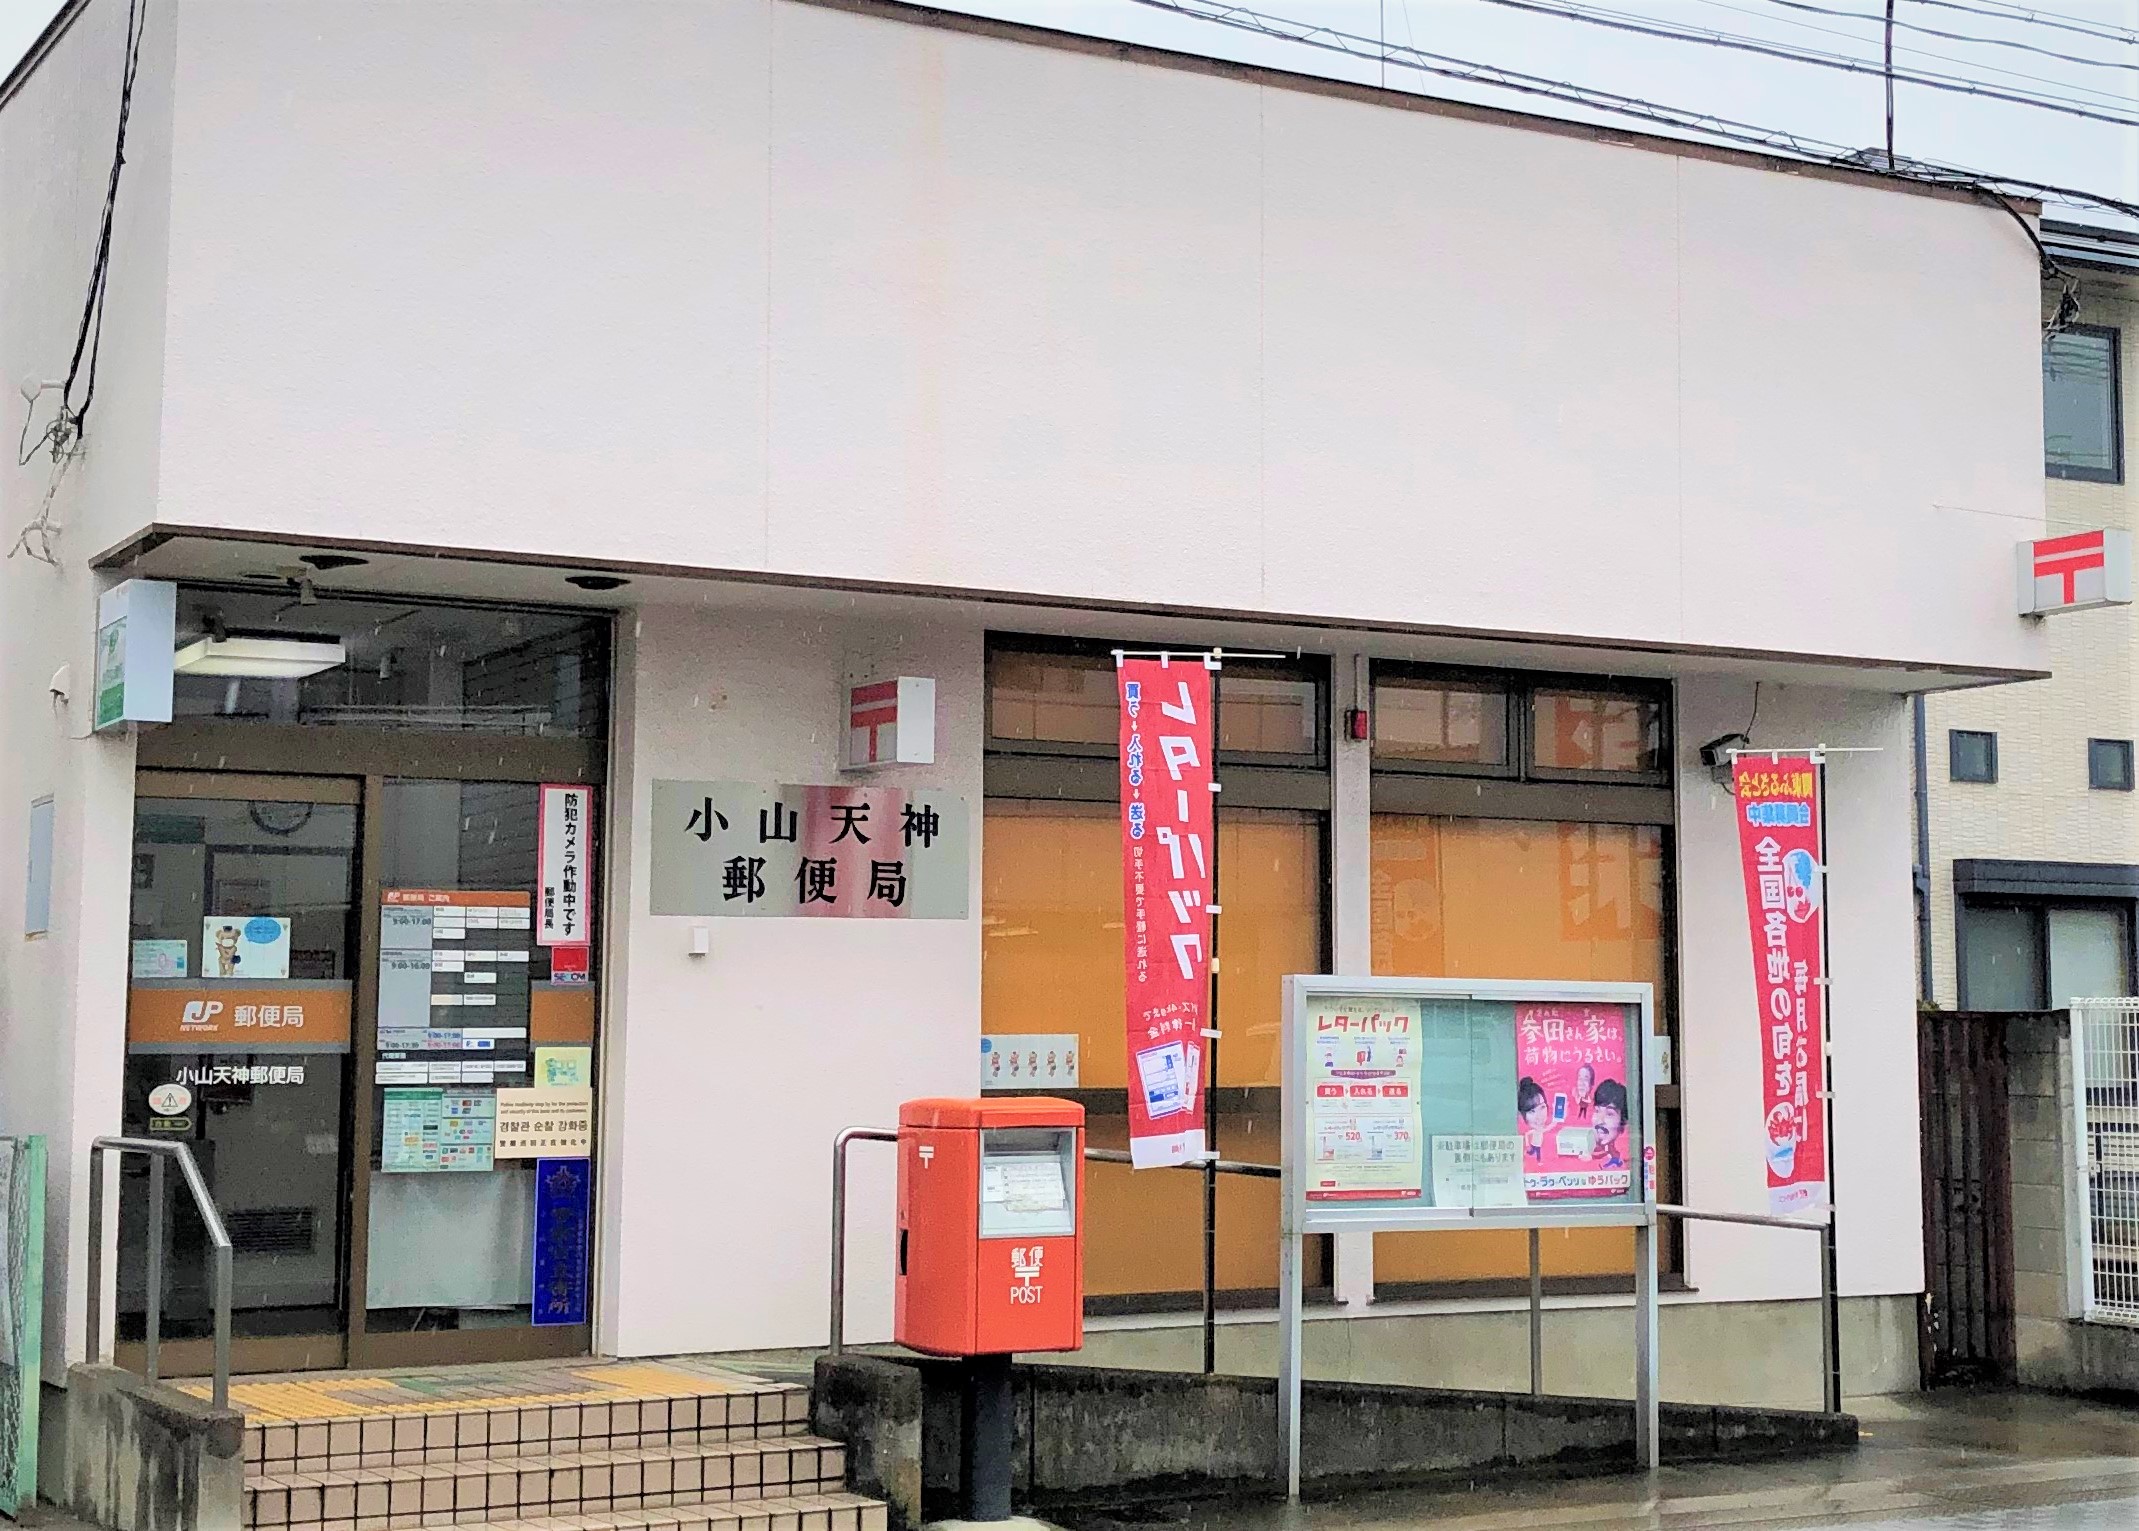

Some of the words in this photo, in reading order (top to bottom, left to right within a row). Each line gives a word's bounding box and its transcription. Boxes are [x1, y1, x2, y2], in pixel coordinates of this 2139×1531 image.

[684, 797, 940, 848] 小山天神
[563, 793, 579, 936] 防犯カメラ作動中です
[722, 855, 907, 908] 郵便局
[234, 1005, 304, 1028] 郵便局
[1317, 1013, 1409, 1033] レターパック
[176, 1066, 305, 1085] 小山天神郵便局
[1011, 1246, 1045, 1268] 郵便
[1010, 1286, 1044, 1304] POST
